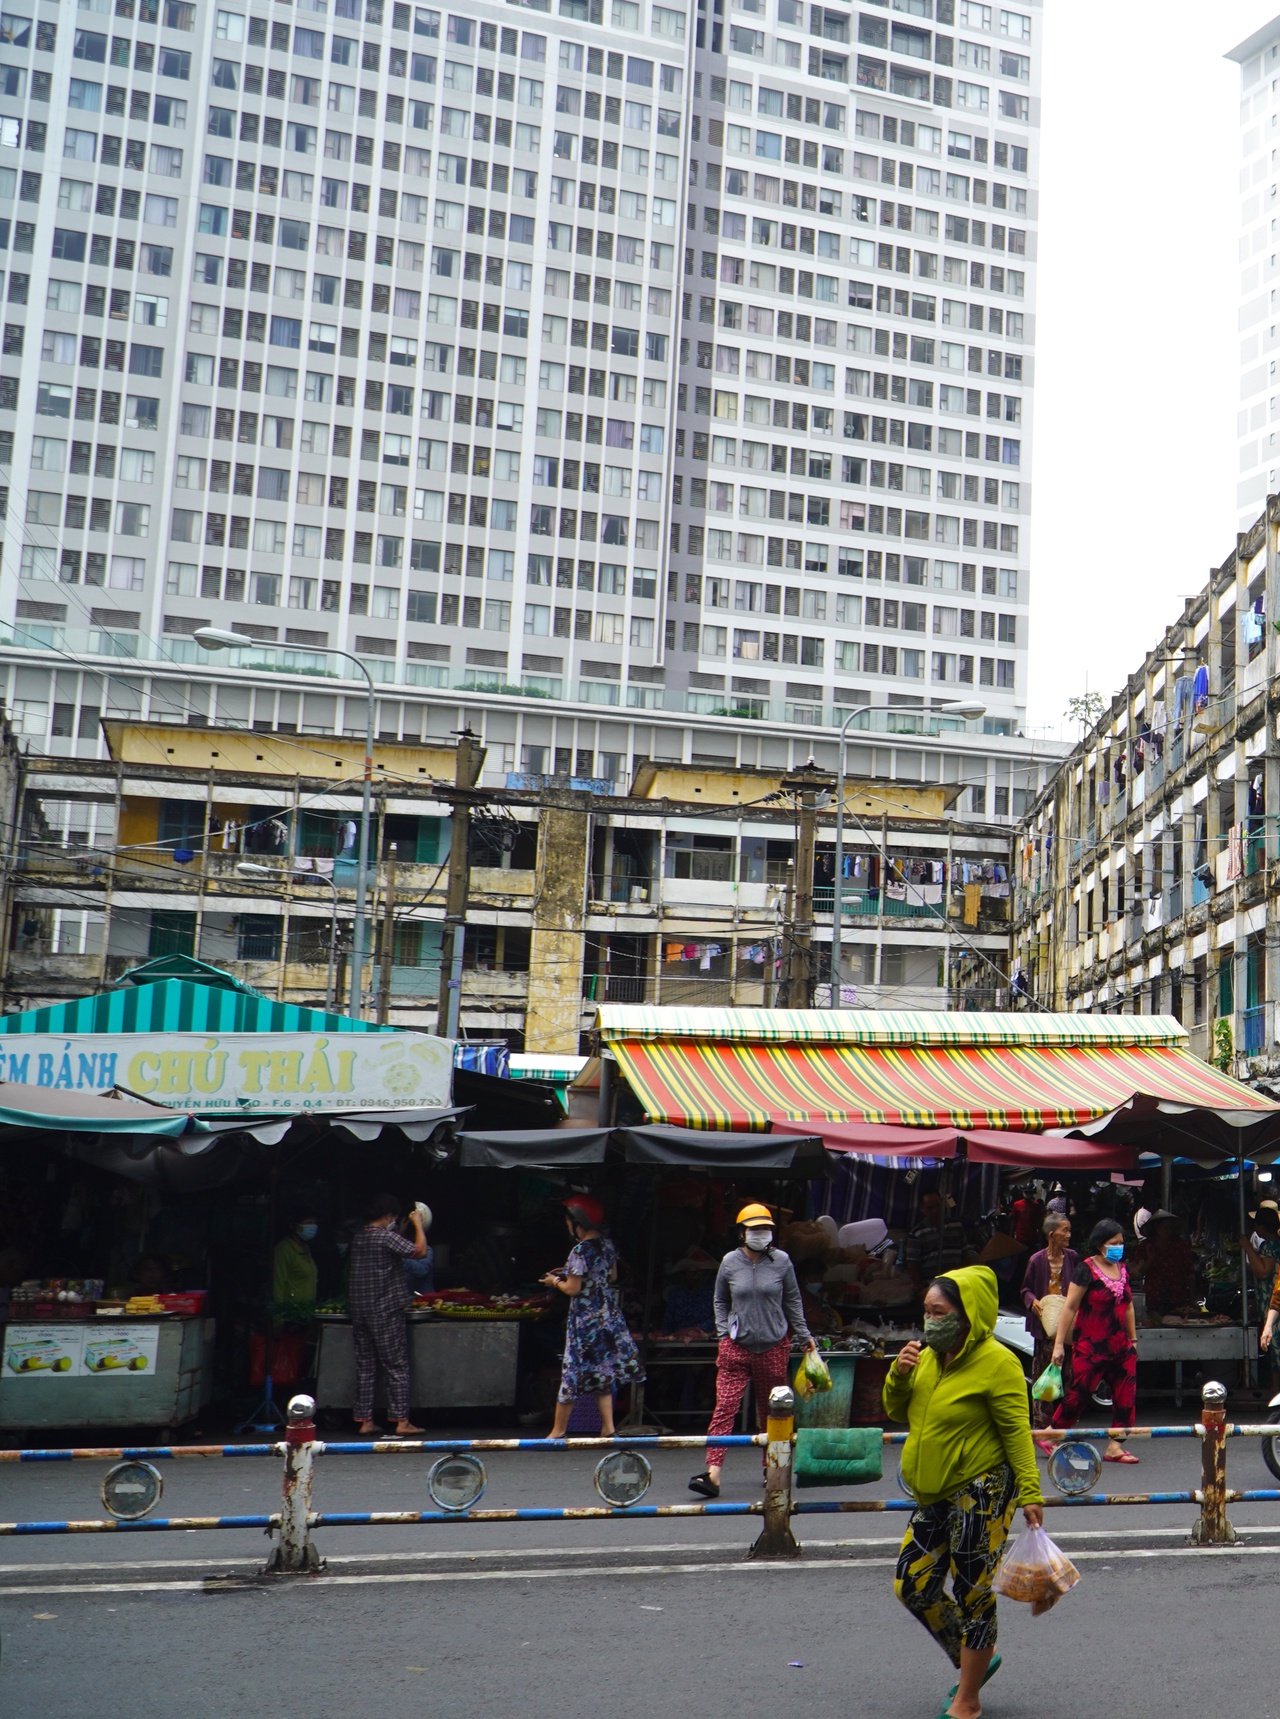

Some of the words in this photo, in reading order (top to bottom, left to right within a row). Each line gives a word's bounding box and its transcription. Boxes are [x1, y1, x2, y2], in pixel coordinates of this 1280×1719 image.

[37, 1042, 118, 1089] BÁNH
[127, 1038, 229, 1094] CHÚ
[238, 1038, 357, 1093] THÁI
